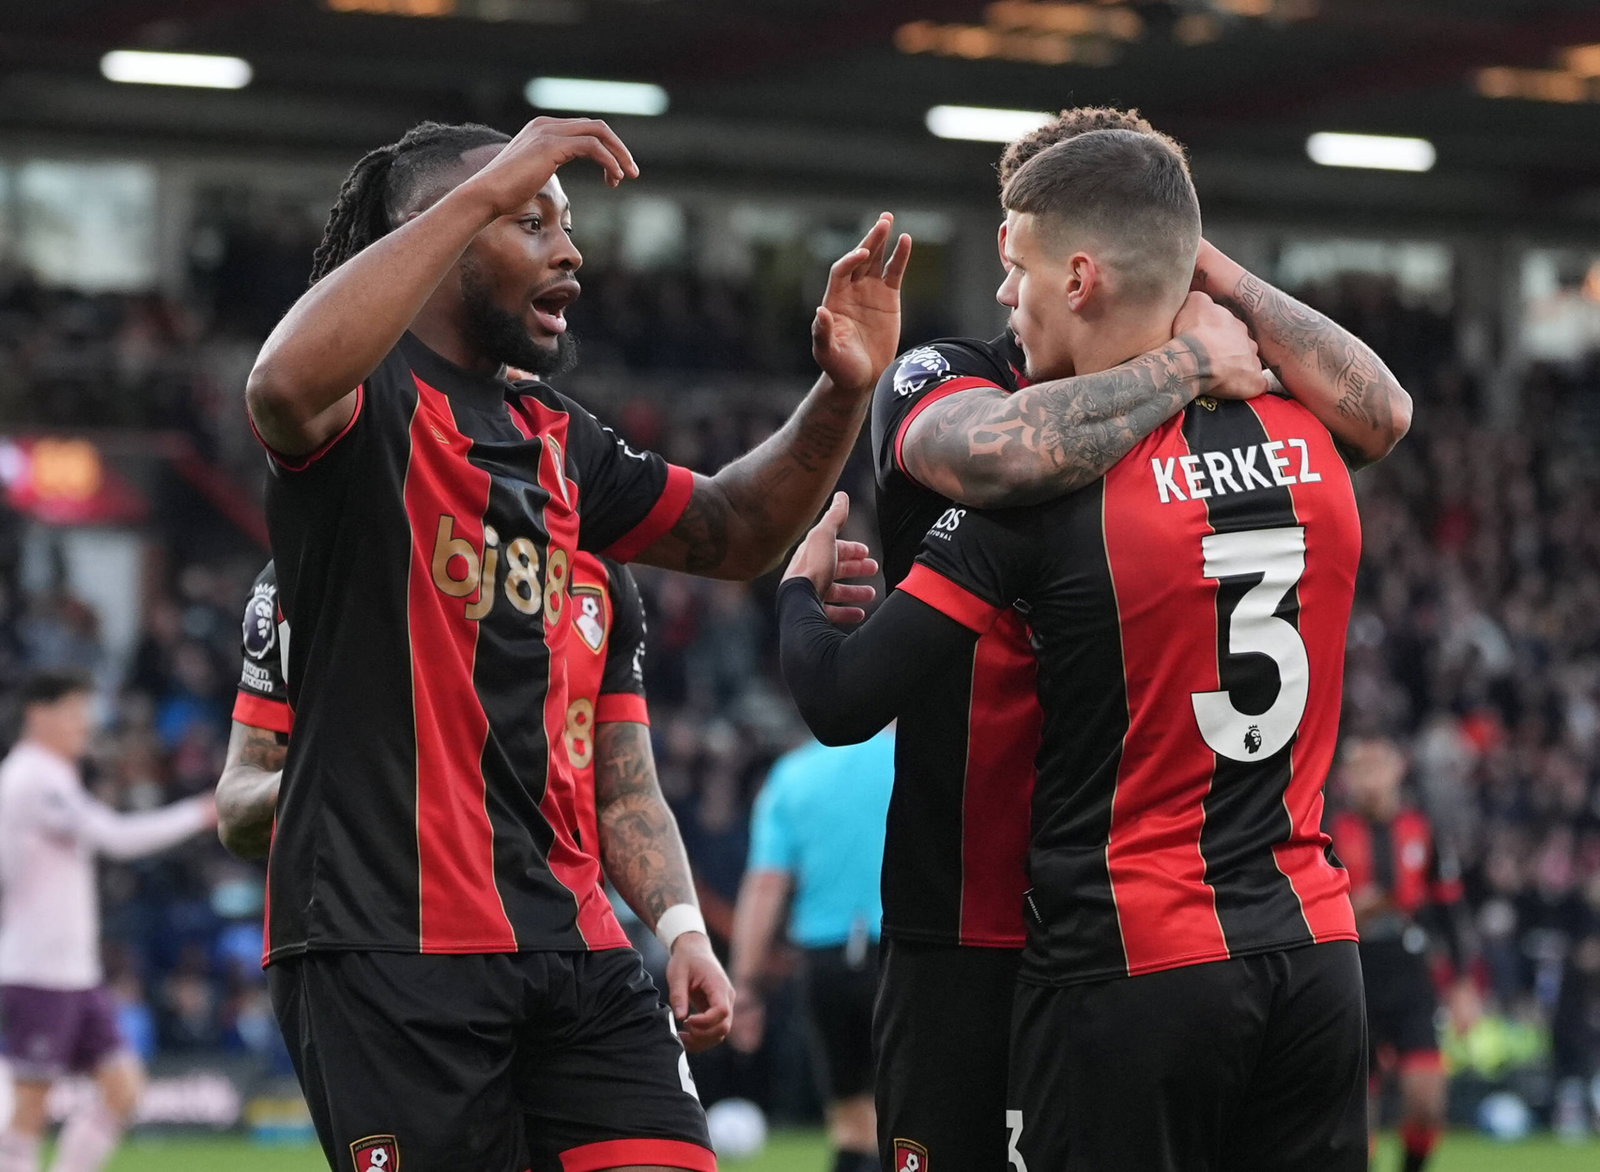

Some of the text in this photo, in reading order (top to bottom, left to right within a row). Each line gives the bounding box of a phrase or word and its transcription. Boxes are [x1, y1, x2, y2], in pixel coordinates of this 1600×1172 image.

[1151, 438, 1323, 504] KERKEZ
[432, 514, 568, 627] bj88
[1191, 526, 1310, 763] 3
